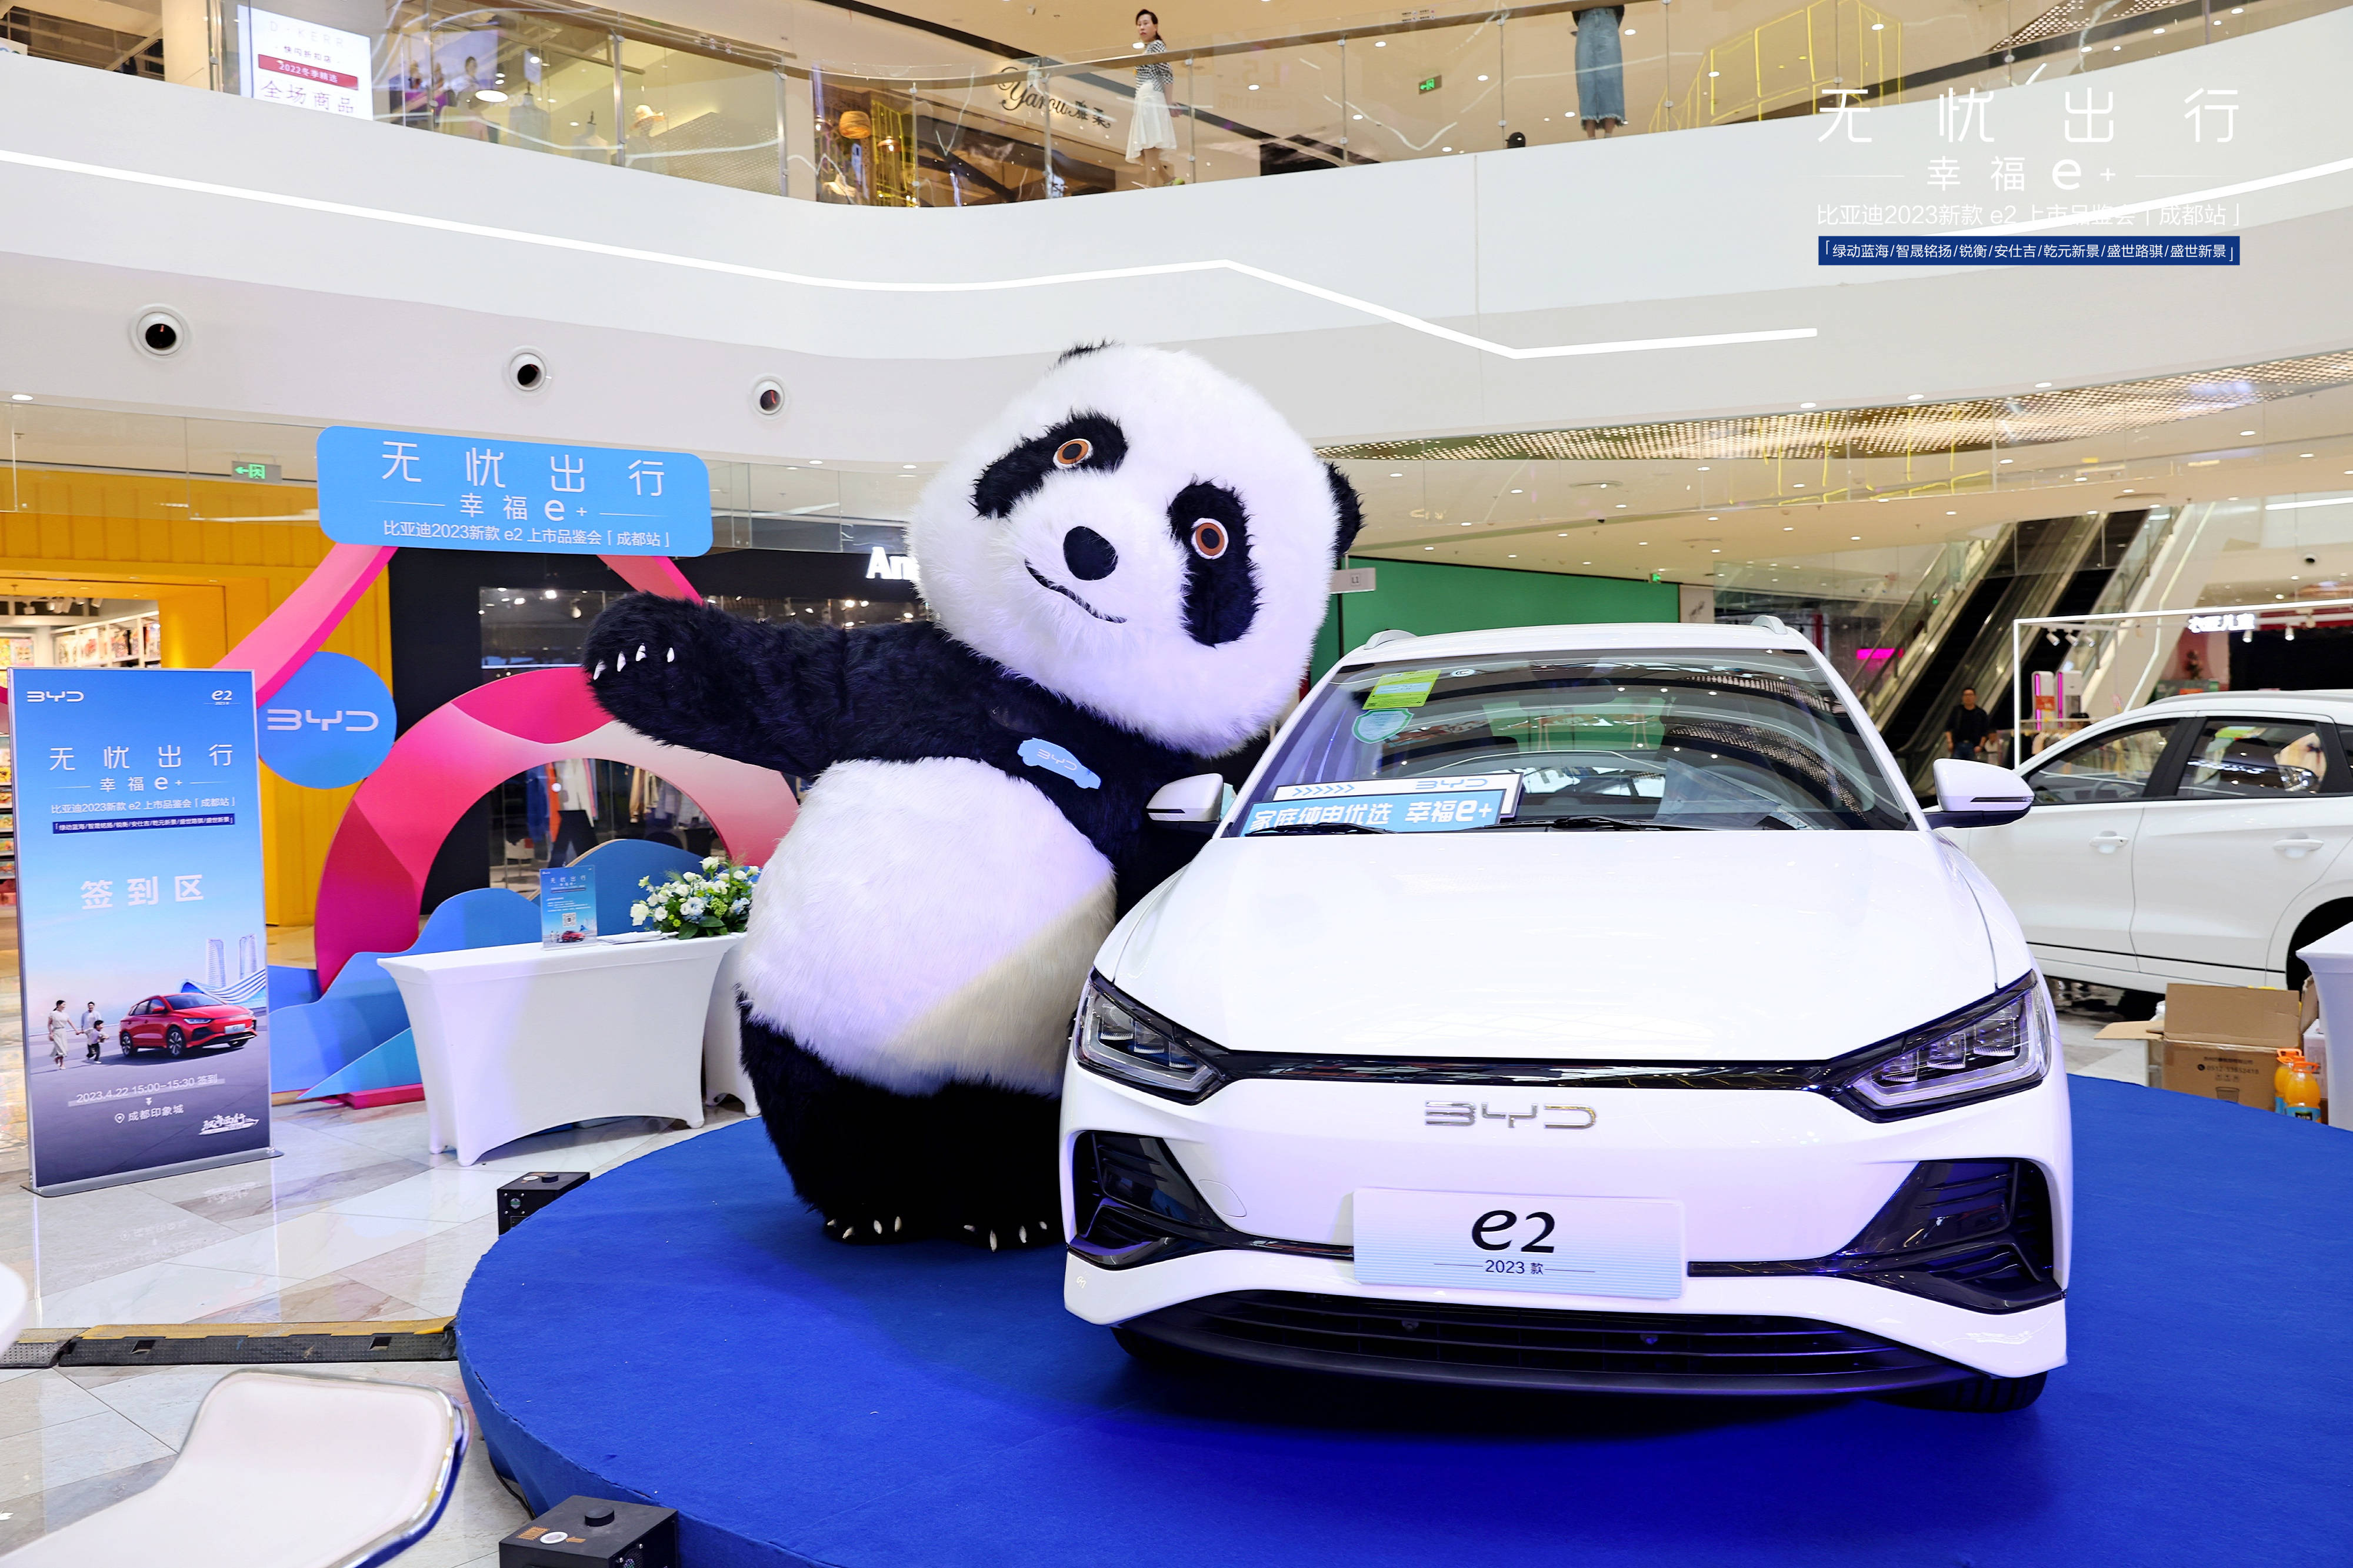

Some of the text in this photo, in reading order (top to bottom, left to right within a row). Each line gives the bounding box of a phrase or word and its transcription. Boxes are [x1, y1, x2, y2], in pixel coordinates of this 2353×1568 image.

[279, 62, 338, 83] 2022冬季精选
[261, 80, 354, 114] 全场商品
[382, 441, 665, 496] 无忧出行
[459, 493, 588, 522] 幸福e+
[384, 520, 501, 541] 比亚迪2023新款
[504, 528, 523, 541] e2
[26, 690, 85, 702] BYD
[211, 689, 233, 701] e2
[267, 709, 379, 732] BYD
[49, 743, 233, 771] 无忧出行
[1036, 749, 1078, 771] BYD
[1415, 778, 1488, 790] BYD
[51, 802, 126, 814] 比亚迪2023新款
[129, 802, 141, 810] e2
[1405, 800, 1492, 823] 幸福e+
[81, 874, 204, 910] 签到区
[76, 1073, 218, 1103] 2023.4.22 15:00-15:30 签到
[128, 1104, 184, 1122] 成都印象城
[1425, 1100, 1597, 1130] BYD
[1471, 1209, 1555, 1254] e2
[1485, 1260, 1544, 1275] 2023 款
